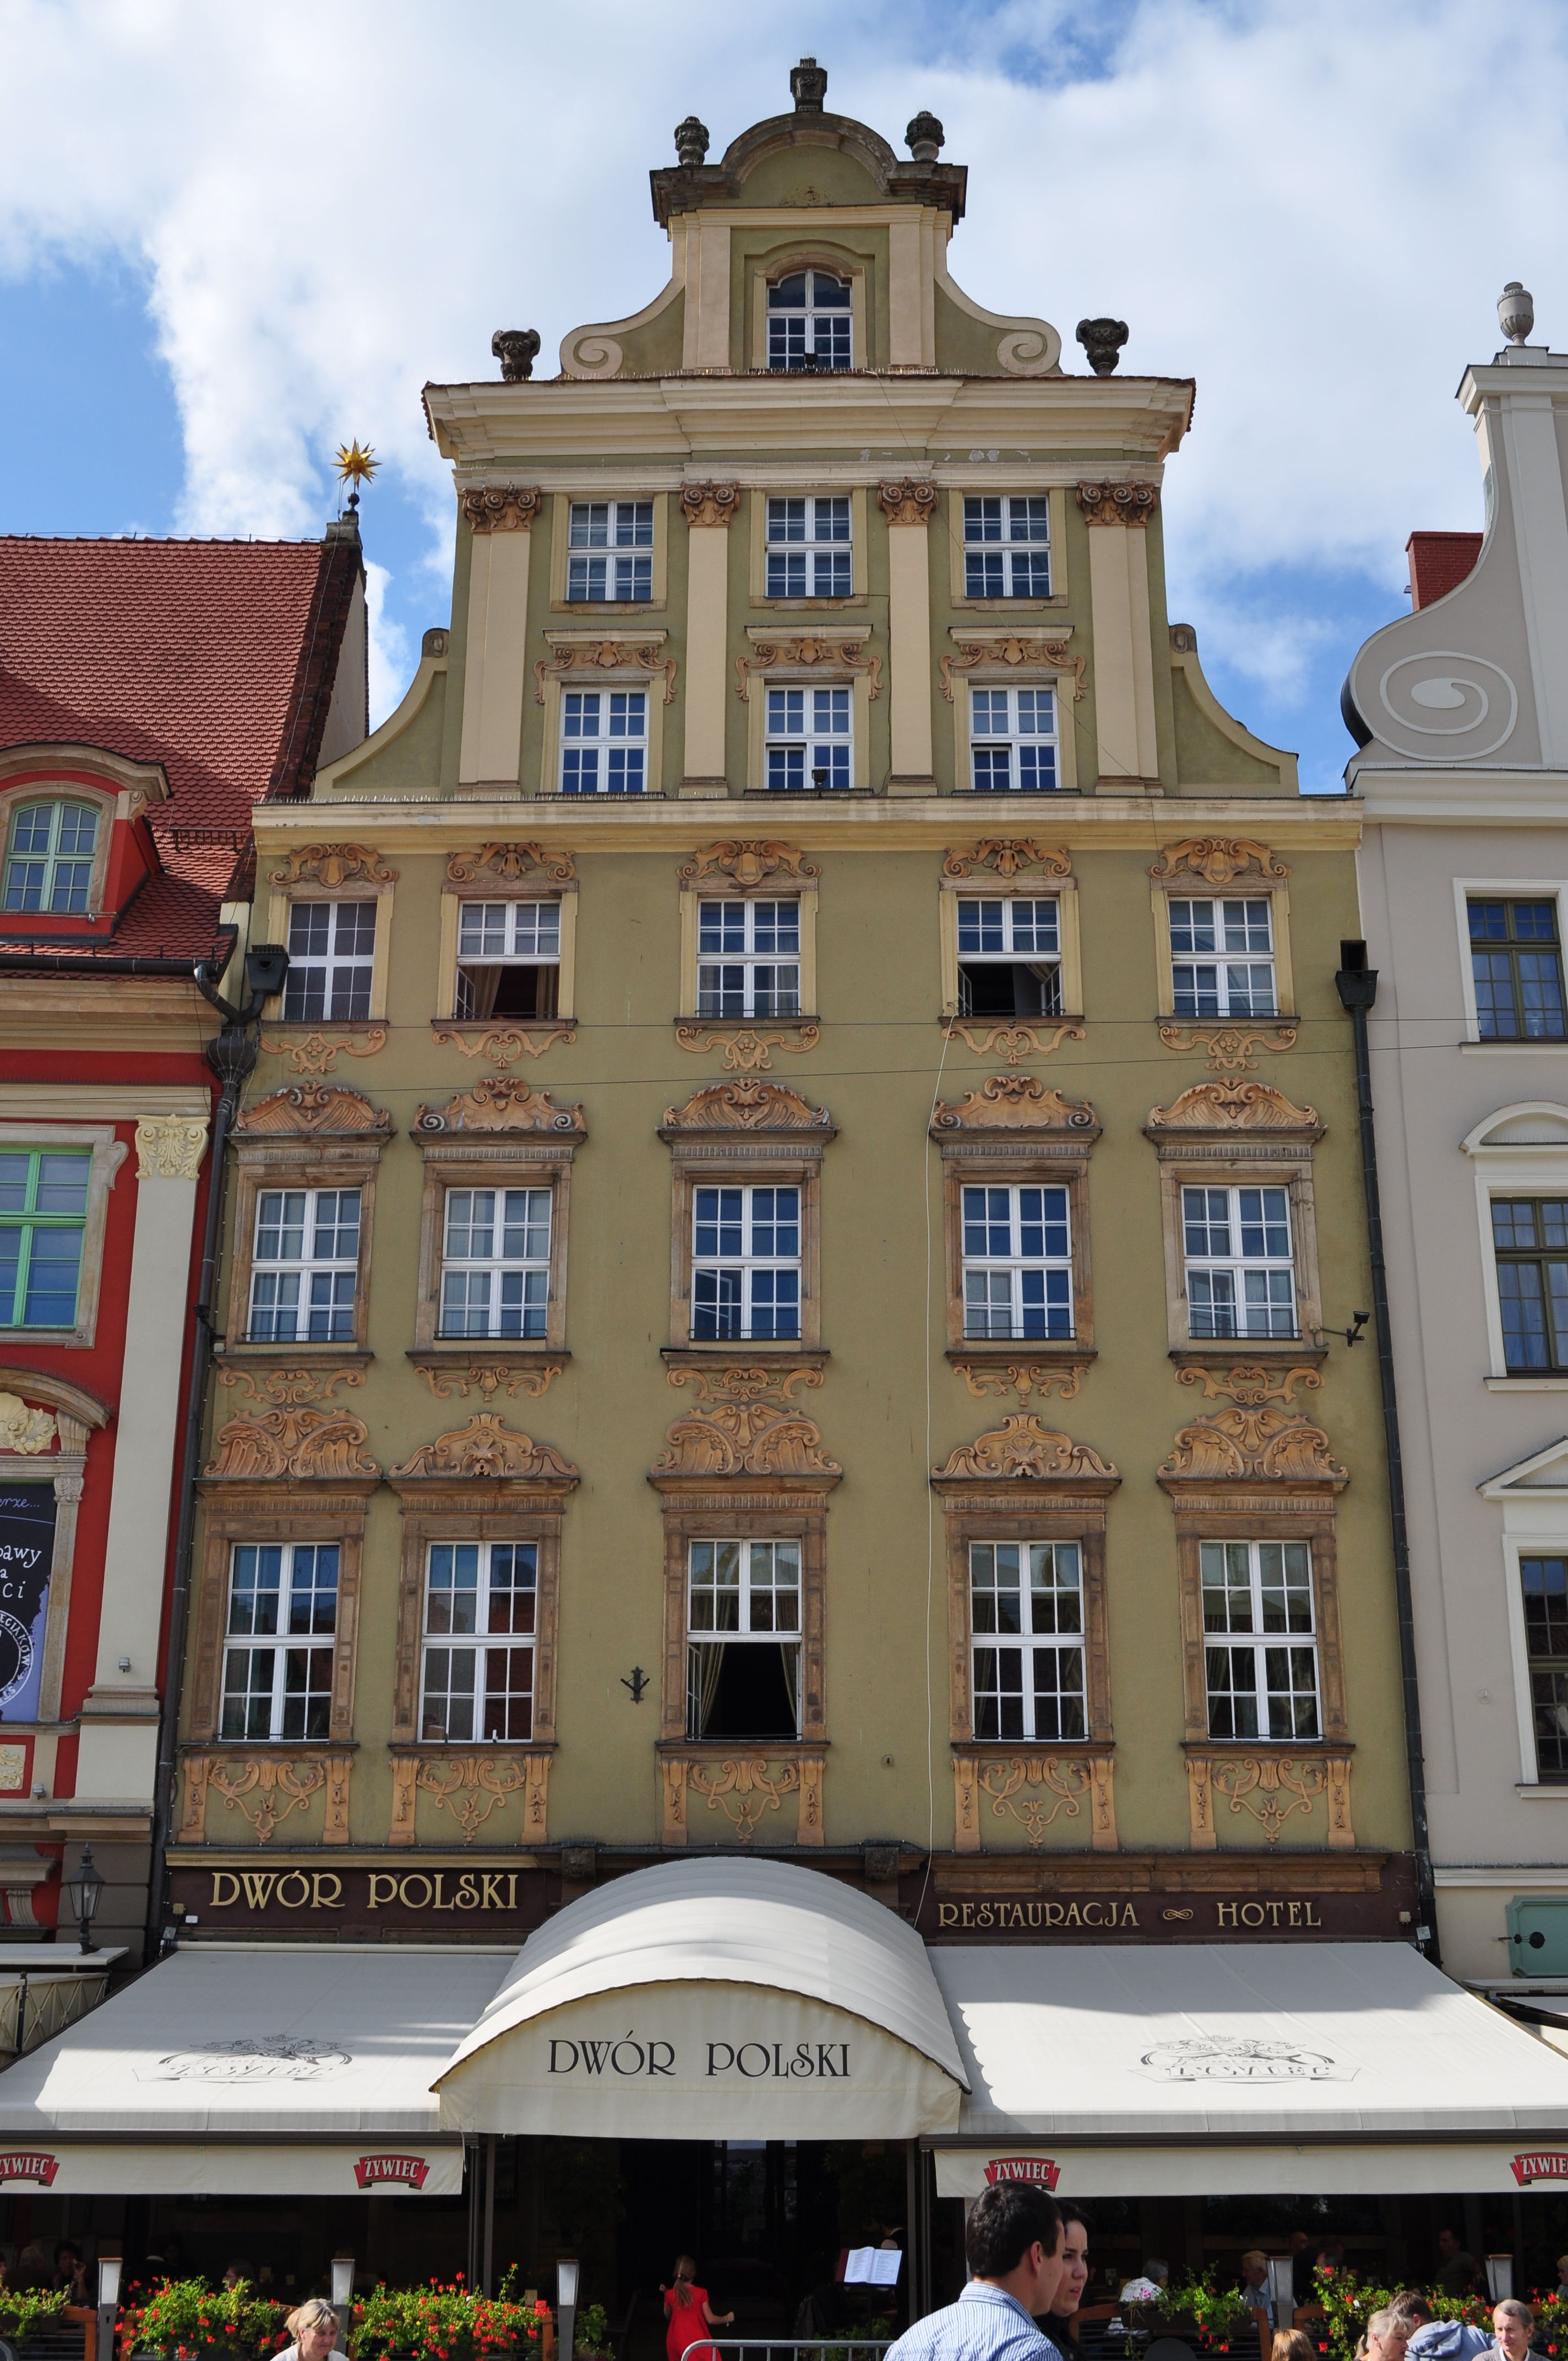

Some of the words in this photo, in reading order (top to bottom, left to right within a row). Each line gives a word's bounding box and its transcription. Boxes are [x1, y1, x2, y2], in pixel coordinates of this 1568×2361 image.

[209, 1870, 345, 1910] DWÓR
[367, 1874, 518, 1911] POLSKI
[938, 1902, 1140, 1928] RESTAURACJA
[1217, 1902, 1321, 1927] HOTEL
[547, 2030, 676, 2076] DWÓR
[705, 2042, 851, 2079] POLSKI
[364, 2157, 420, 2178] ŻYWIEC
[994, 2161, 1049, 2180] ŻYWIEC
[1520, 2156, 1568, 2174] ŻYWIE
